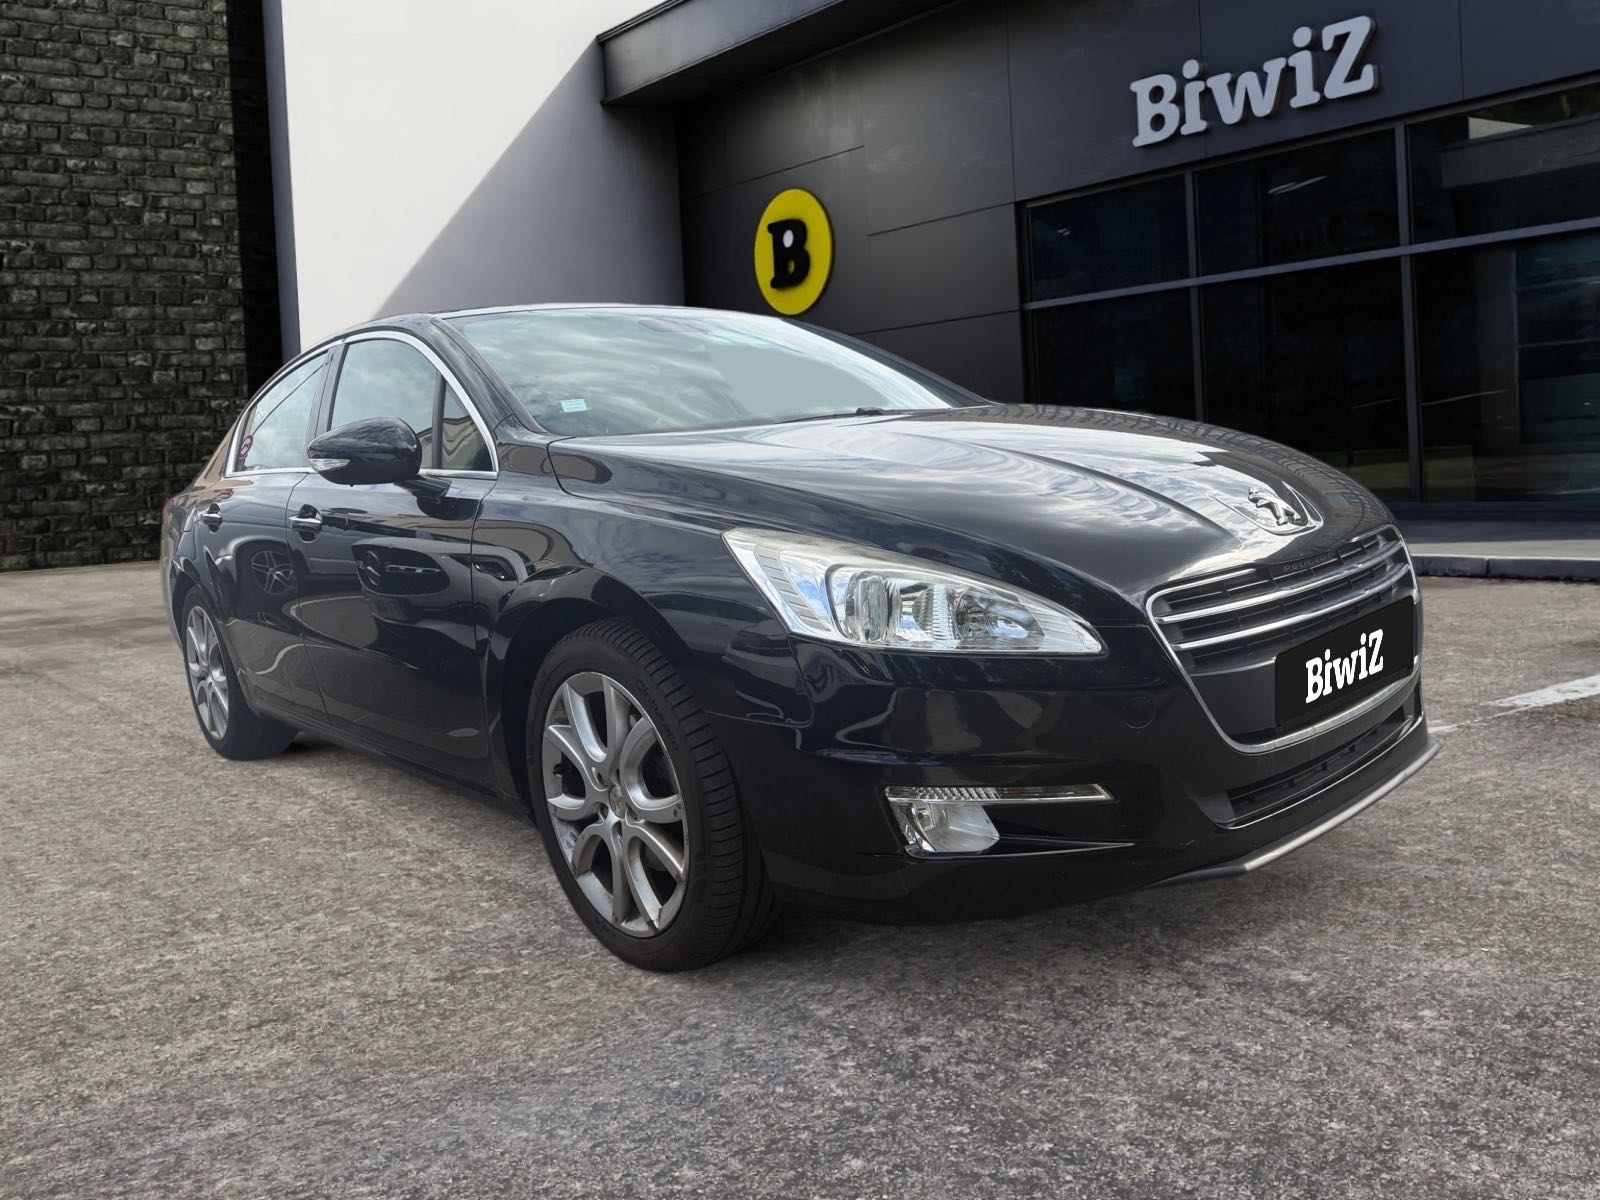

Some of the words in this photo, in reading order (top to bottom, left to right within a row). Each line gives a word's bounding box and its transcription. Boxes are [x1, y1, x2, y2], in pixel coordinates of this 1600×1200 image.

[1130, 15, 1375, 147] BiwiZ
[767, 218, 811, 289] B
[1305, 628, 1384, 704] BiwiZ
